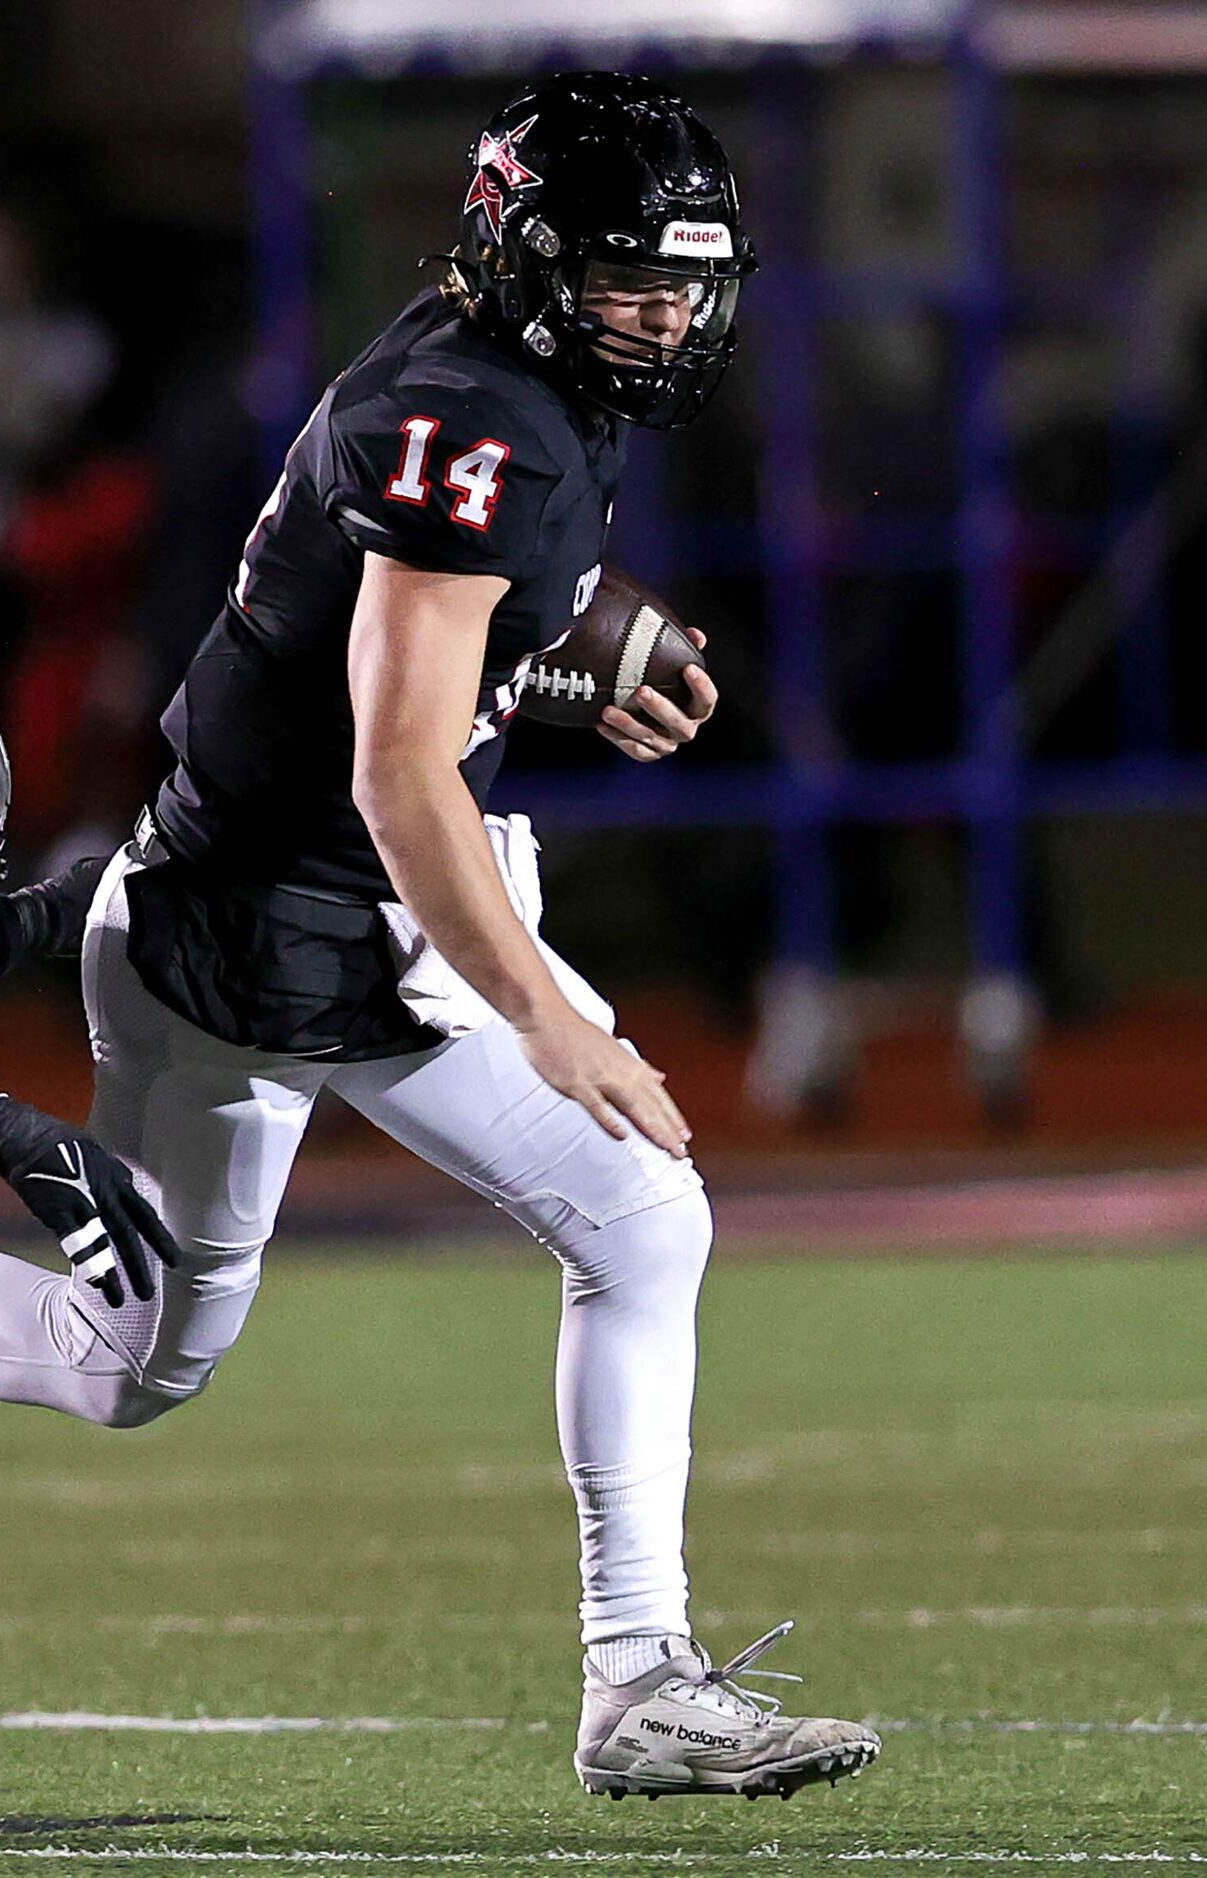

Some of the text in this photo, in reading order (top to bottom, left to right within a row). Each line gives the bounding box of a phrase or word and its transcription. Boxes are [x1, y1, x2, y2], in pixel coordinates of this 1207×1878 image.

[383, 415, 511, 532] 14
[640, 1717, 676, 1737] new
[676, 1724, 742, 1750] balance
